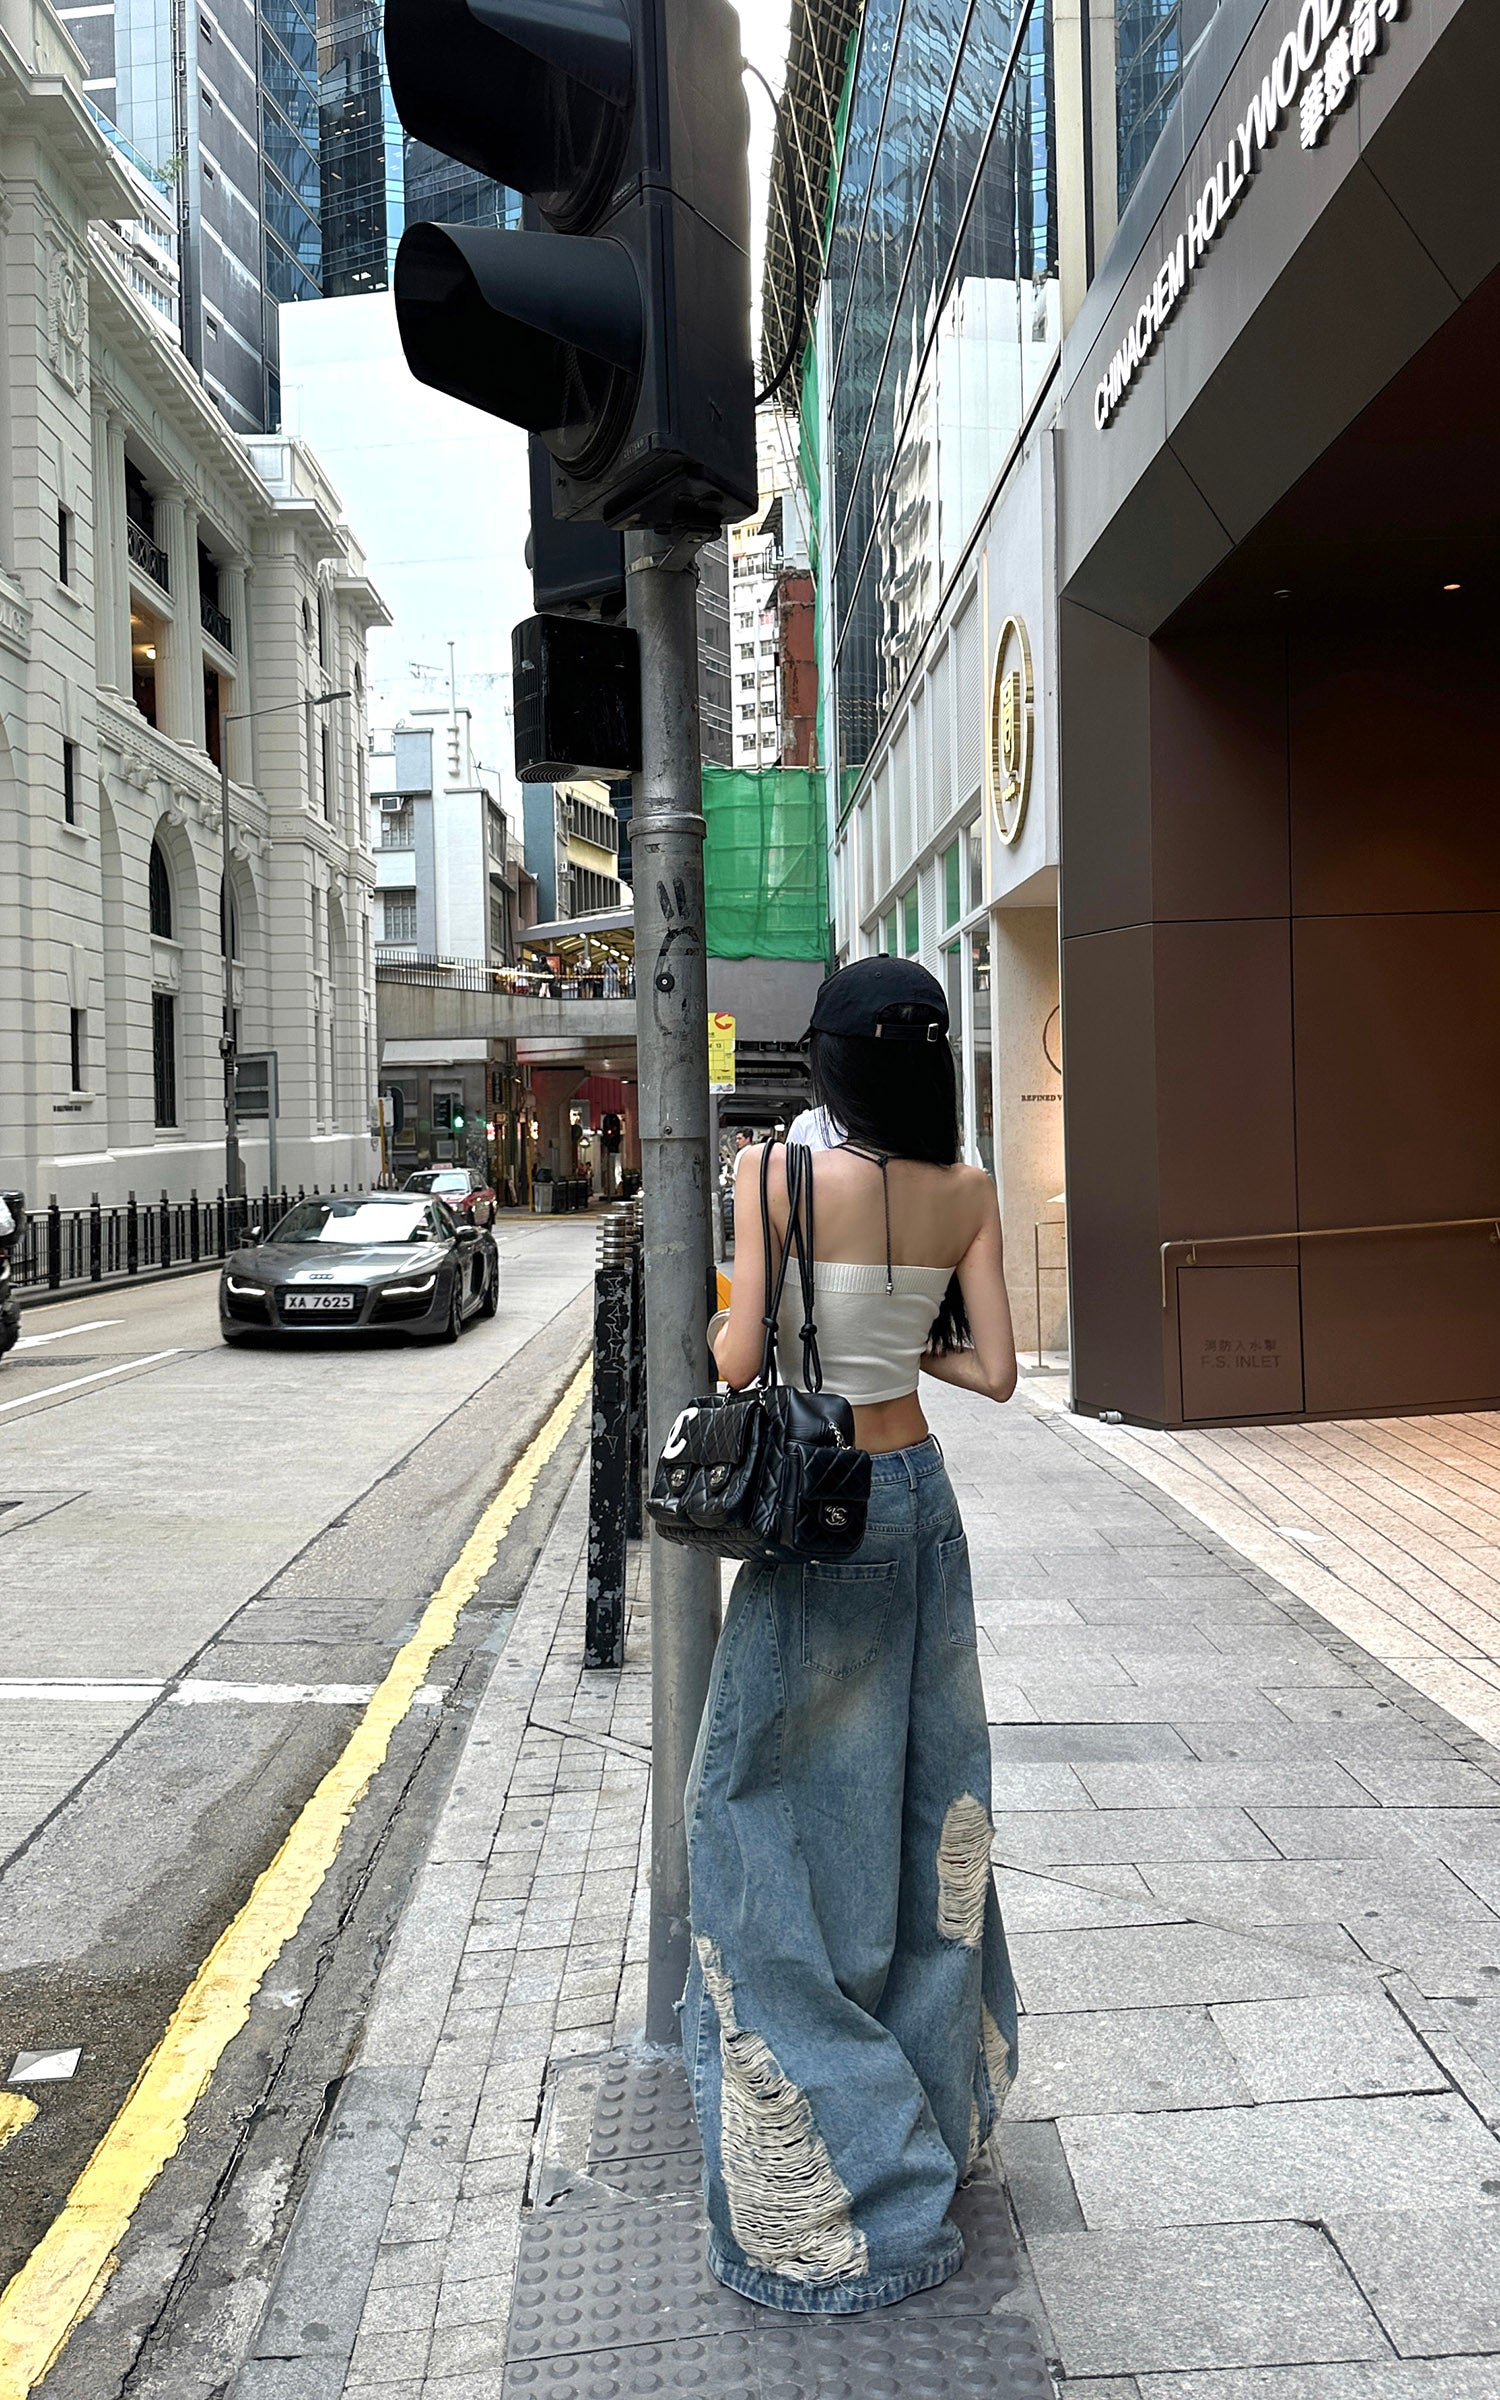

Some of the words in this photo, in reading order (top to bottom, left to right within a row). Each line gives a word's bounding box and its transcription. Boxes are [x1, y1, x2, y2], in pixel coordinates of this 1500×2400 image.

[1094, 235, 1186, 430] CHINACHEM
[1021, 1094, 1056, 1102] REFINED
[288, 1297, 307, 1308] XA
[313, 1296, 351, 1308] 7625
[1201, 1355, 1231, 1369] F.S.
[1236, 1355, 1281, 1368] INLET
